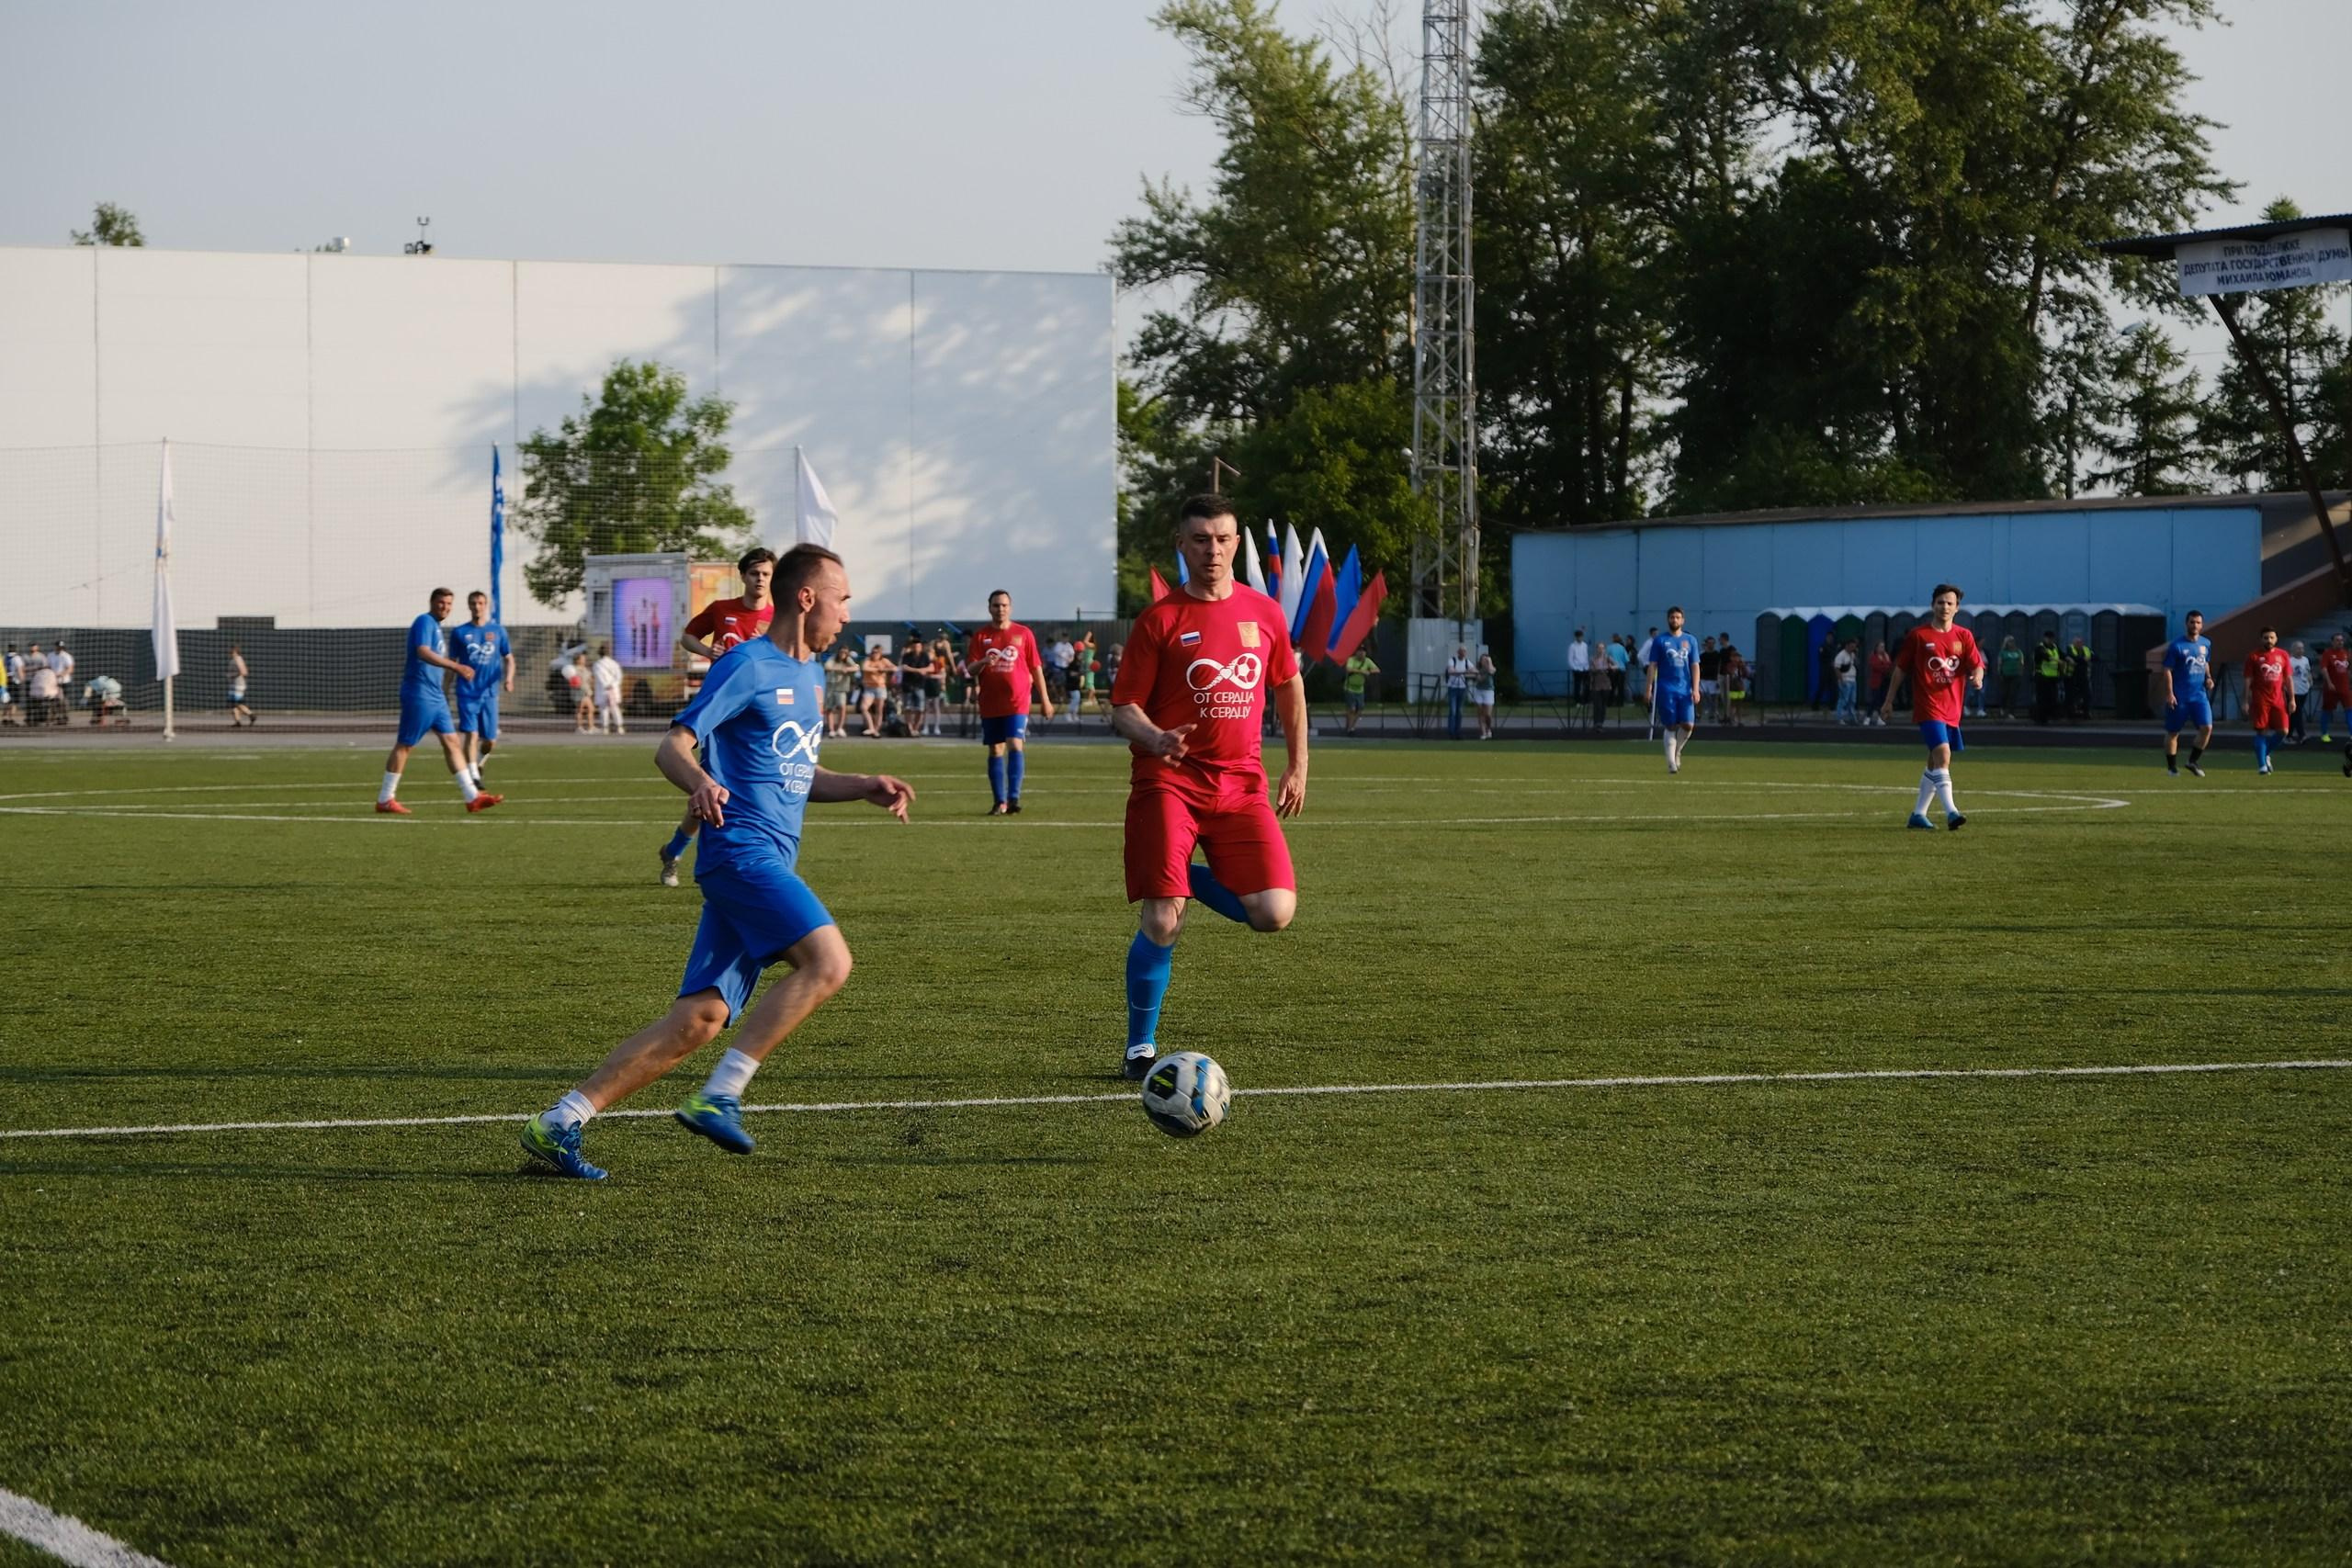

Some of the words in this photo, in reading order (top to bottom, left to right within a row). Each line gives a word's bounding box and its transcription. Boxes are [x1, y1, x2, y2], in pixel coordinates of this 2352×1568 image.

[2223, 244, 2244, 257] ПРИ
[2184, 260, 2229, 276] ДЕПУТАТА
[2318, 247, 2349, 264] ДУМЫ
[2217, 271, 2265, 286] МИХАИЛА
[1193, 692, 1212, 704] ОТ
[1214, 692, 1255, 705] СЕРДЦА
[1200, 707, 1208, 718] К
[1210, 706, 1251, 719] СЕРДЦУ
